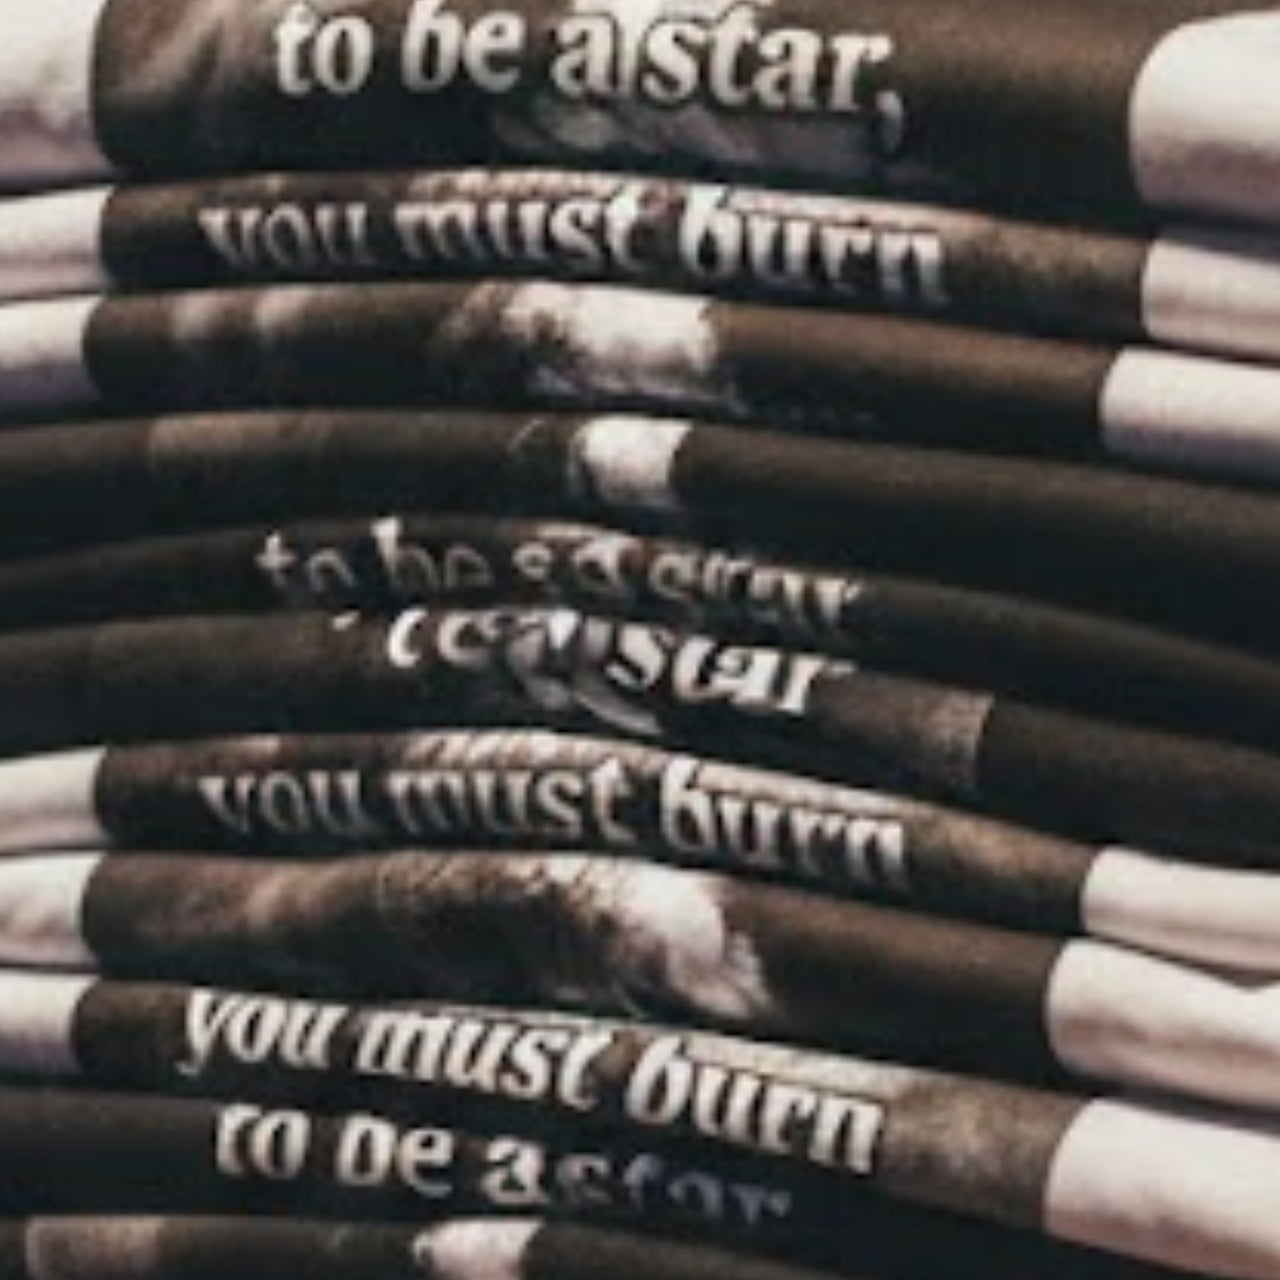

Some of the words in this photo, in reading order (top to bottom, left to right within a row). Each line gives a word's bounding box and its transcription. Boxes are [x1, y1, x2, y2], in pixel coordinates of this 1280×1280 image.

[275, 3, 372, 96] to
[550, 14, 617, 100] a
[393, 182, 645, 272] must
[678, 182, 948, 304] burn
[387, 755, 635, 844] must
[659, 752, 909, 884] burn
[177, 987, 350, 1077] you
[354, 1008, 613, 1112] must
[625, 1030, 886, 1176] burn
